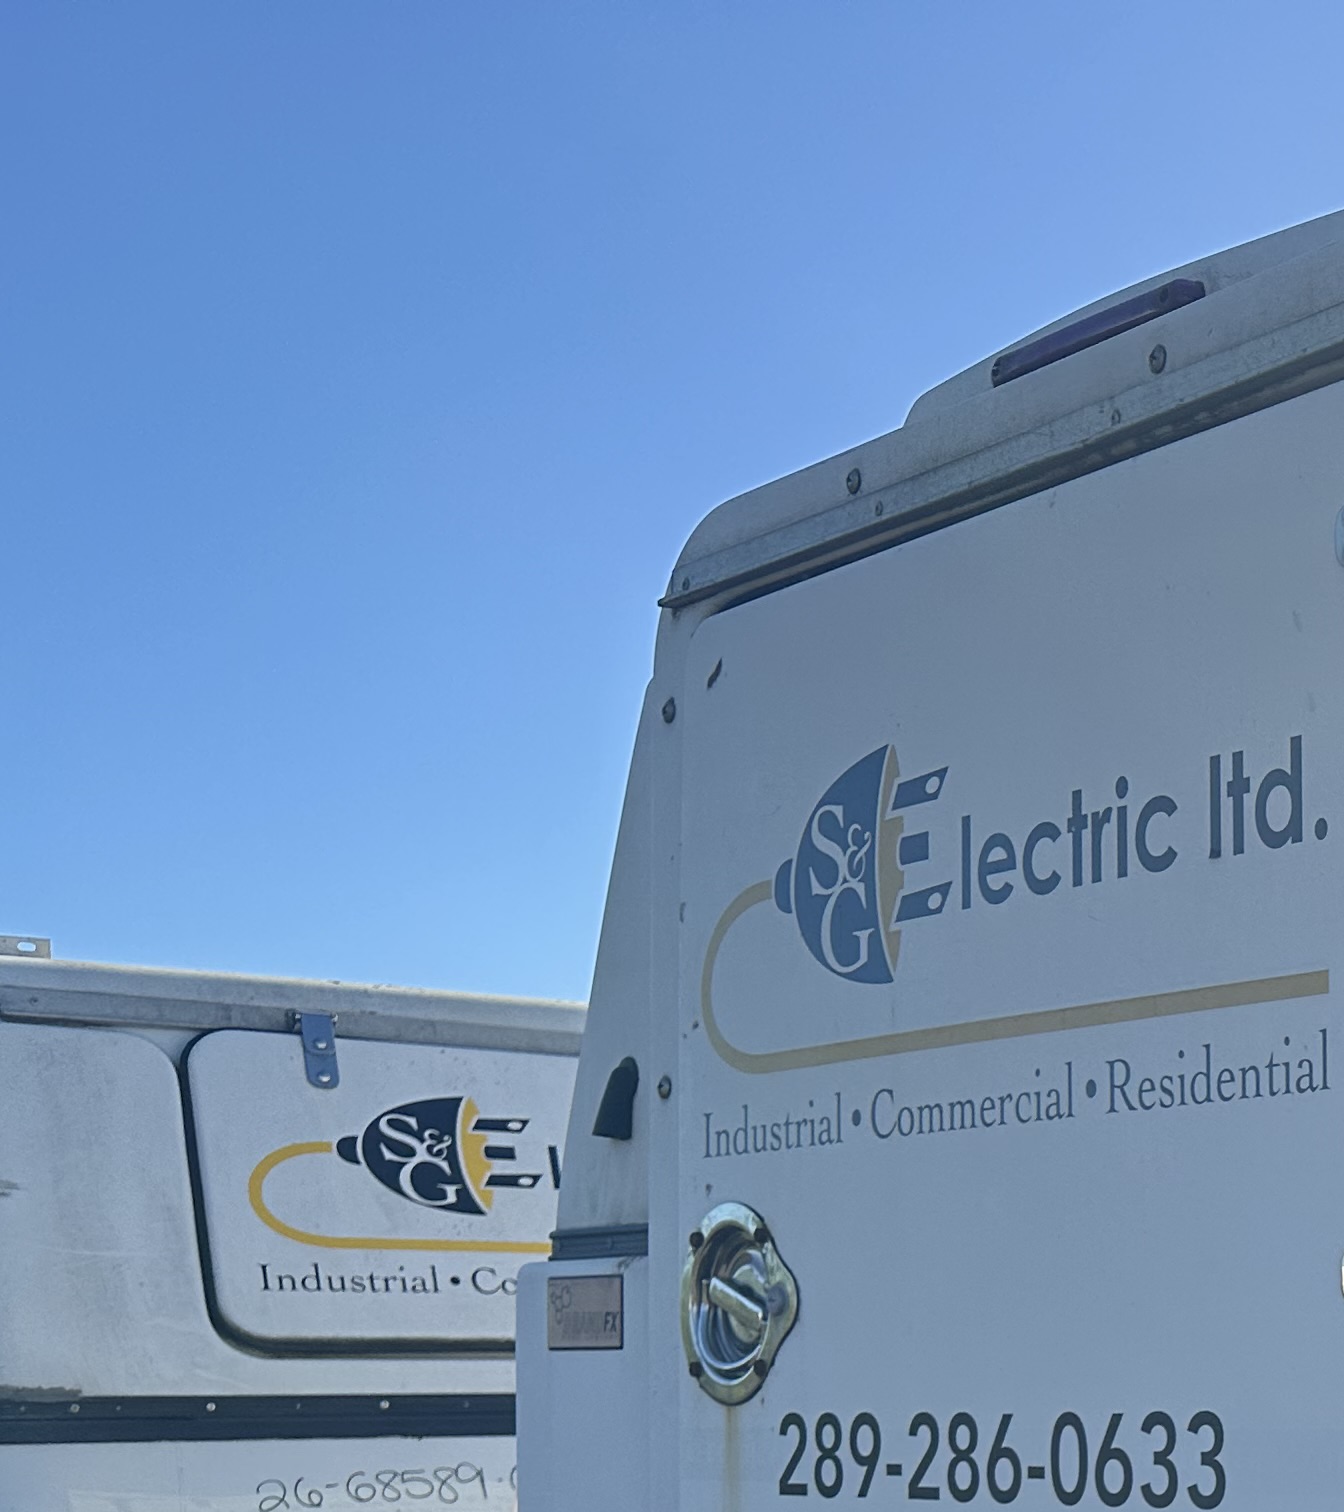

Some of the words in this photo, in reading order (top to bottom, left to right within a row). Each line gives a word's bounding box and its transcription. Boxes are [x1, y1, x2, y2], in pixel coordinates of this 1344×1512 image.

[892, 766, 1178, 923] Electric
[1208, 735, 1328, 860] ltd.
[703, 1092, 844, 1158] Industrial
[870, 1062, 1076, 1140] Commercial
[1106, 1029, 1331, 1115] Residential
[258, 1263, 439, 1294] Industrial
[778, 1410, 1226, 1510] 289-286-0633
